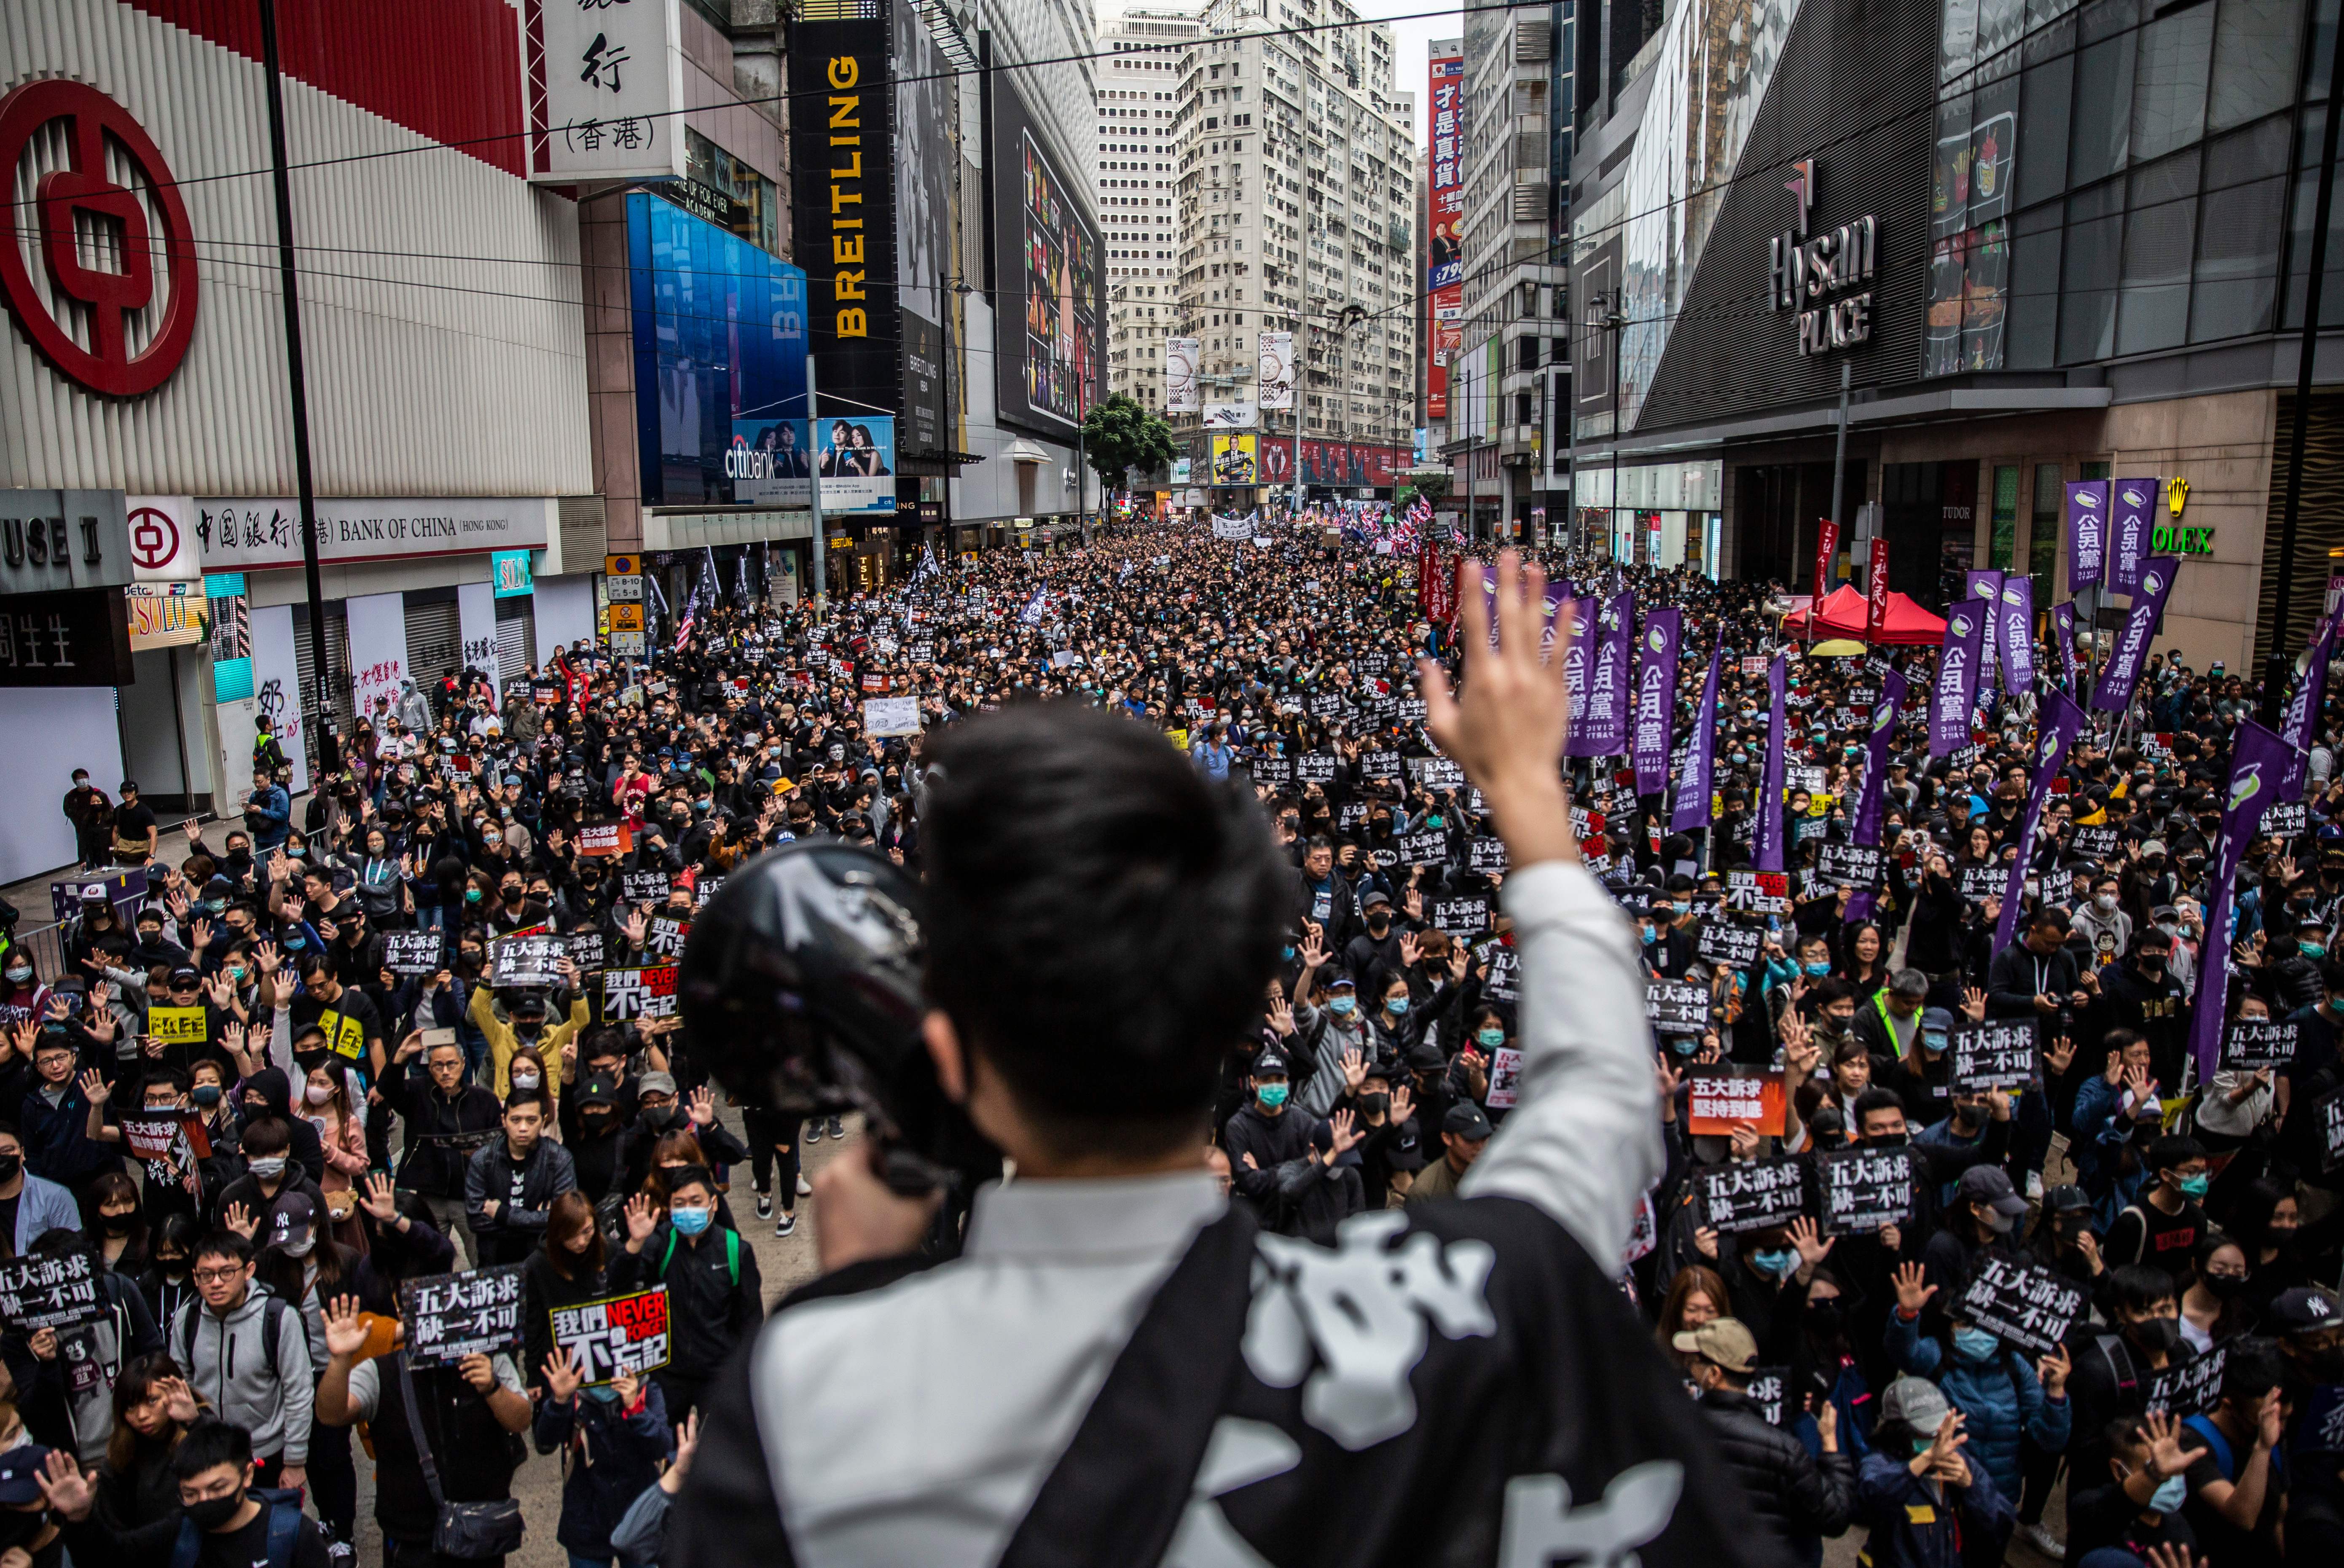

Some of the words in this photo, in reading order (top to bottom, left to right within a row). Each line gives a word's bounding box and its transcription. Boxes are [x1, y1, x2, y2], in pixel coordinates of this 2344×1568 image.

[566, 115, 654, 153] (香港)
[1436, 84, 1455, 188] 才是真貨
[689, 180, 698, 196] UP
[700, 185, 711, 203] FOR
[713, 191, 728, 214] EVER
[827, 56, 867, 339] BREITLING
[686, 197, 716, 223] ACADEMY
[1769, 215, 1875, 327] Hysan
[1799, 293, 1871, 356] PLACE
[910, 354, 936, 379] BREITLING
[725, 443, 776, 479] citibank
[1942, 506, 1970, 519] TUDOR
[340, 519, 384, 542] BANK
[388, 518, 407, 540] OF
[411, 517, 457, 538] CHINA
[459, 519, 484, 534] (HONG
[486, 517, 509, 532] KONG)
[2153, 526, 2213, 553] OLEX
[831, 537, 853, 548] BREITLING
[501, 558, 526, 590] SOLO
[623, 589, 638, 597] 5-8
[136, 597, 185, 635] SOLO
[1298, 757, 1335, 767] 五大訴求
[1362, 752, 1399, 765] 五大訴求
[581, 825, 618, 838] 五大訴求
[1399, 830, 1445, 851] 五大訴求
[2076, 827, 2118, 841] 五大訴求
[1400, 844, 1447, 862] 缺一不可
[1821, 843, 1879, 865] 五大訴求
[622, 872, 669, 887] 五大訴求
[1729, 872, 1755, 886] 我們
[1755, 873, 1789, 887] NEVER
[1818, 858, 1877, 881] 缺一不可
[1963, 868, 2009, 882] 五大訴求
[623, 883, 669, 897] 缺一不可
[1434, 900, 1486, 915] 五大訴求
[1434, 913, 1486, 928] 缺一不可
[387, 935, 440, 950] 五大訴求
[500, 940, 565, 957] 五大訴求
[1701, 926, 1759, 948] 五大訴求
[387, 949, 439, 964] 缺一不可
[1698, 938, 1757, 961] 缺一不可
[605, 971, 641, 989] 我們
[641, 967, 679, 986] NEVER
[1646, 985, 1709, 1004] 五大訴求
[1955, 1025, 2033, 1052] 五大訴求
[2231, 1023, 2298, 1042] 五大訴求
[2228, 1041, 2296, 1058] 缺一不可
[1955, 1048, 2033, 1077] 缺一不可
[1693, 1078, 1762, 1098] 五大訴求
[1693, 1099, 1763, 1120] 堅持到底
[1707, 1162, 1801, 1198] 五大訴求
[1830, 1154, 1909, 1187] 五大訴求
[1709, 1185, 1804, 1223] 缺一不可
[1831, 1181, 1911, 1214] 缺一不可
[0, 1254, 90, 1291] 五大訴求
[1, 1277, 95, 1316] 缺一不可
[415, 1274, 519, 1317] 五大訴求
[1979, 1256, 2082, 1317] 五大訴求
[416, 1301, 518, 1345] 缺一不可
[555, 1303, 607, 1337] 我們
[607, 1291, 666, 1329] NEVER
[1965, 1280, 2073, 1343] 缺一不可
[625, 1316, 667, 1343] FORGET
